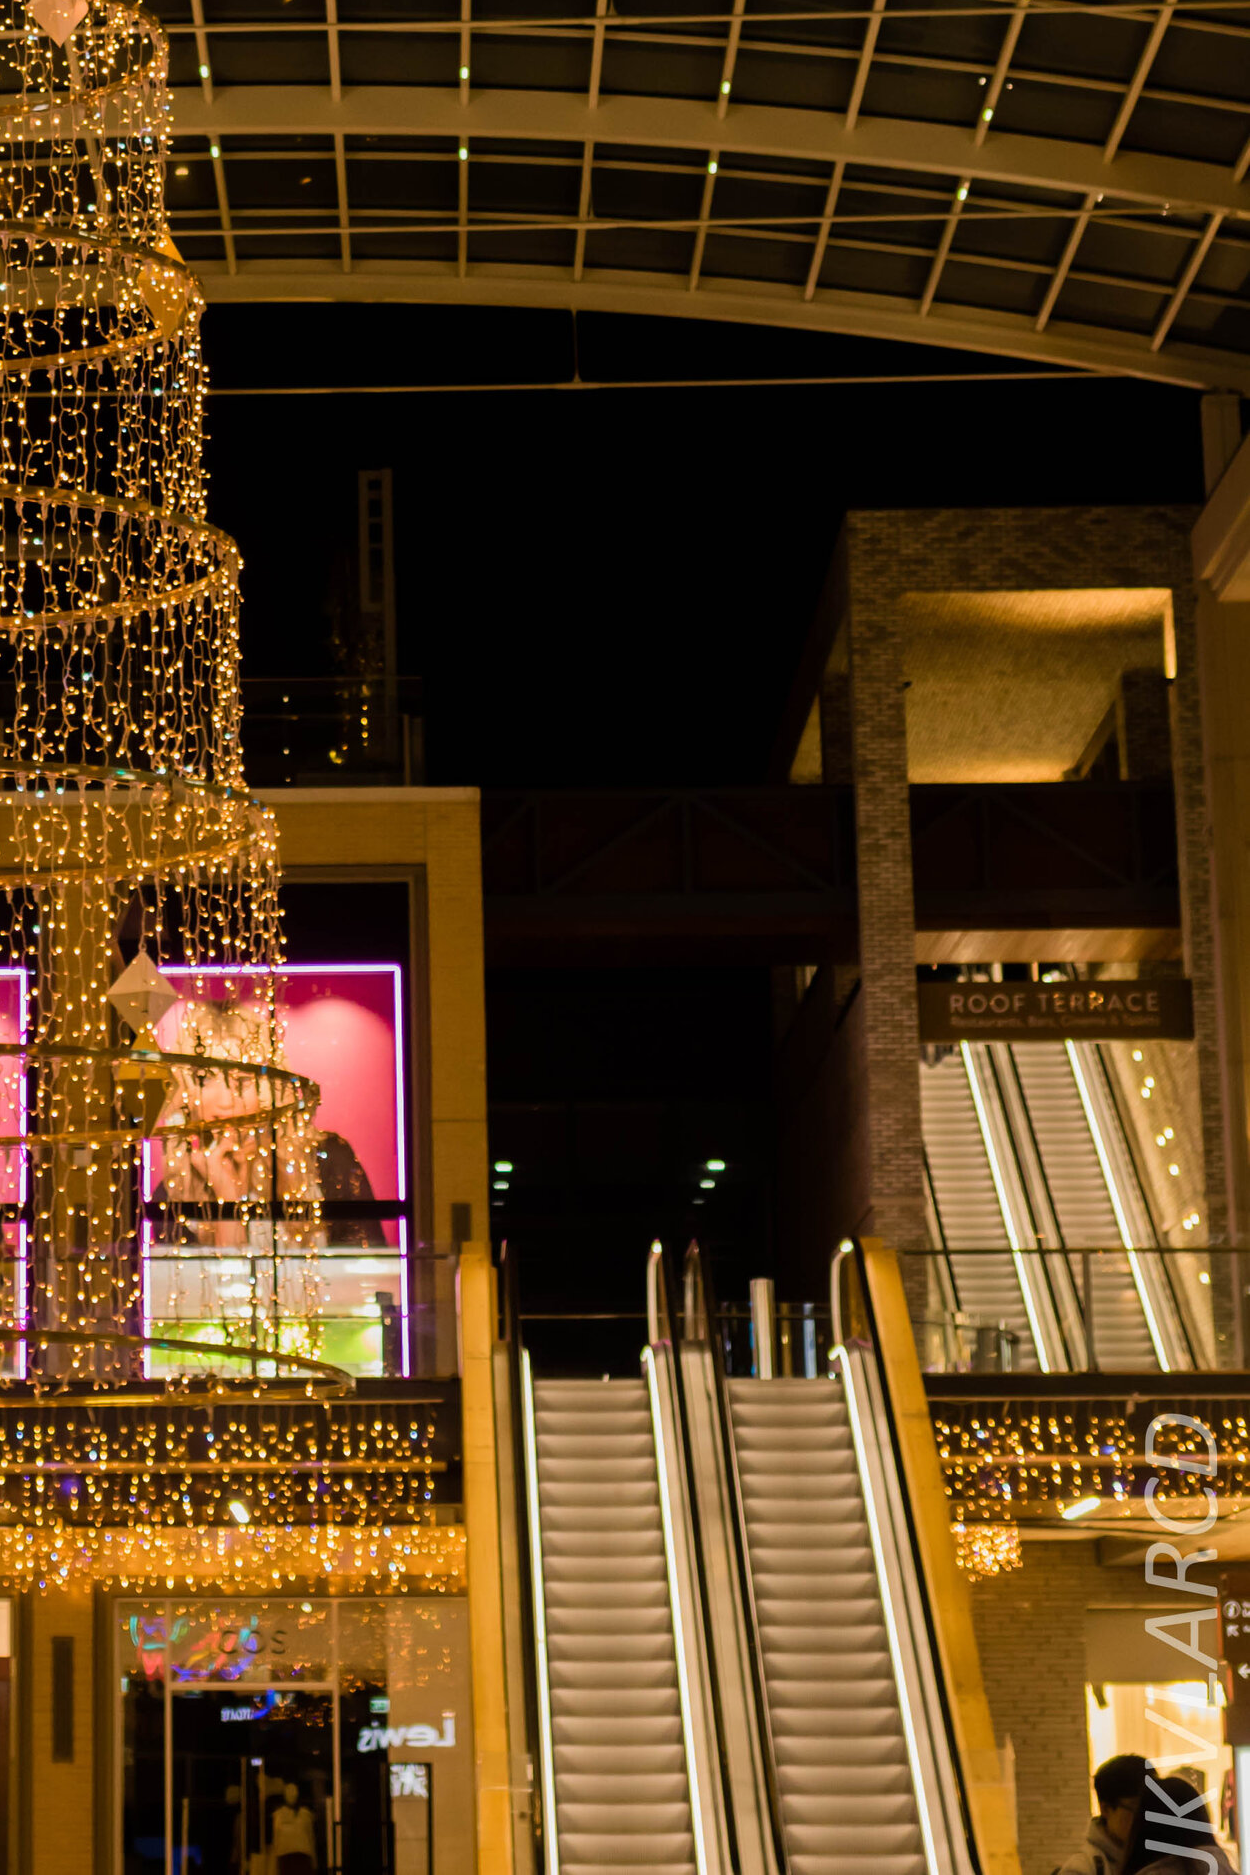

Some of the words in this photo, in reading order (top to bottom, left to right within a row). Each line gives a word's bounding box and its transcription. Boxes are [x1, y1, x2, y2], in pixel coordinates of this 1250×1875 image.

[950, 993, 1026, 1014] ROOF
[1038, 991, 1159, 1013] TERRACE
[220, 1630, 287, 1655] COS
